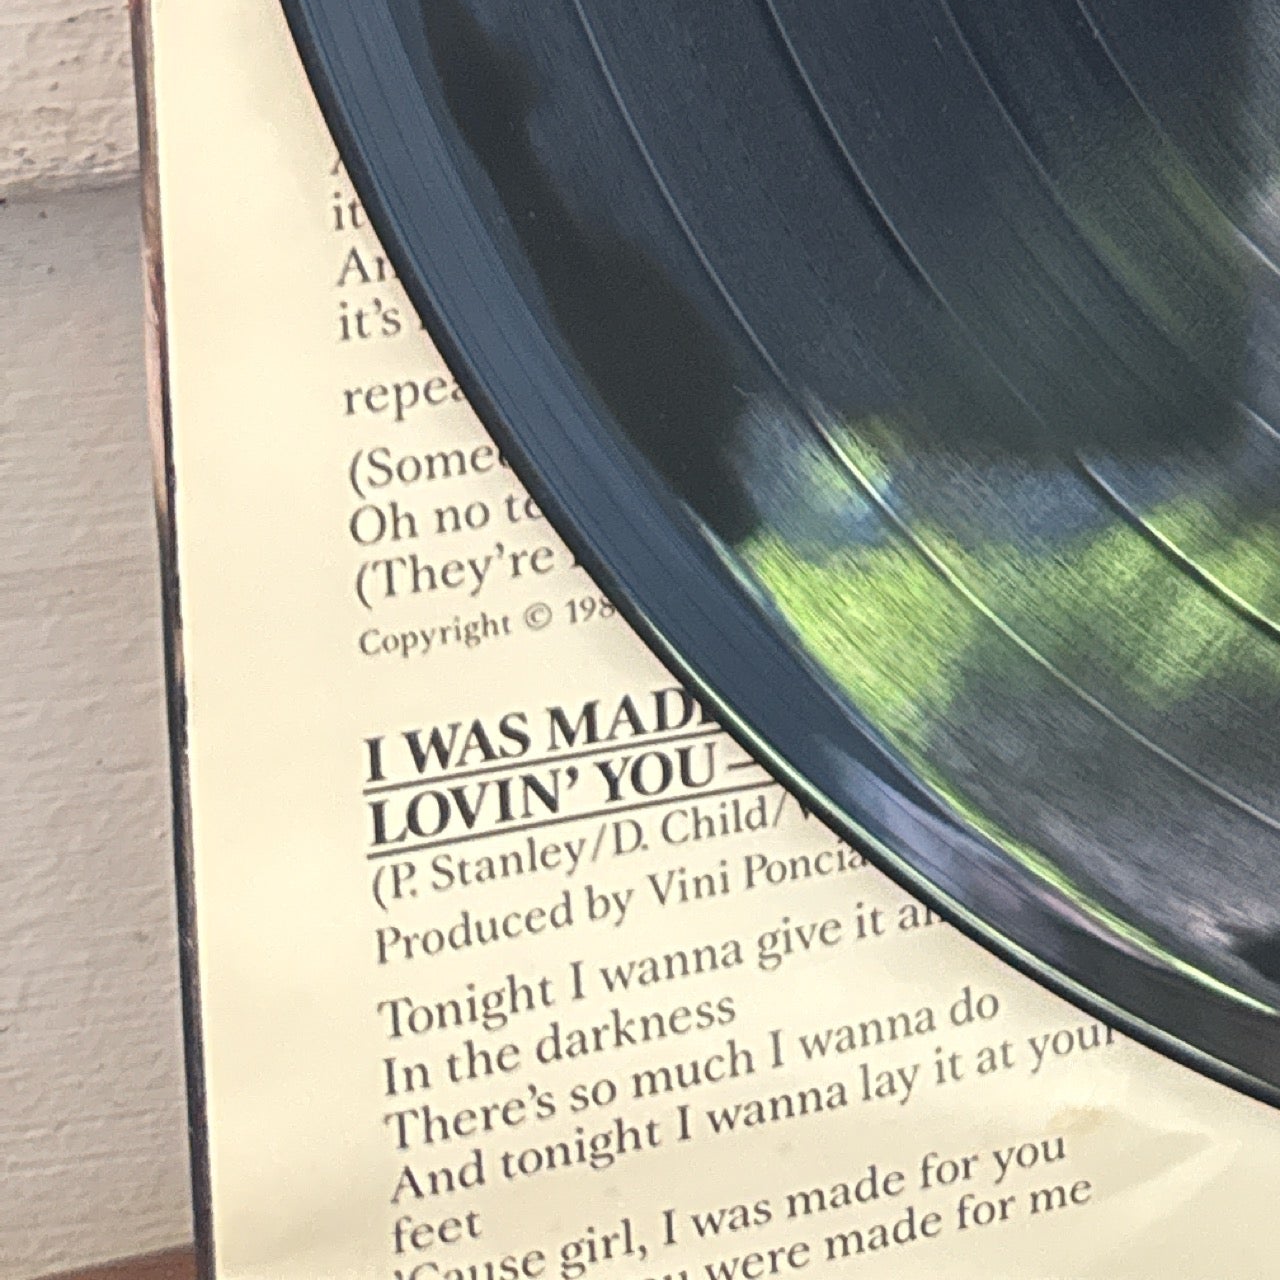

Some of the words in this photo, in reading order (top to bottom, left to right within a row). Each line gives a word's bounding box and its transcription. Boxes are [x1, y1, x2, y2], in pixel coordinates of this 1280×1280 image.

[355, 542, 554, 602] (They're
[359, 612, 511, 658] Copyright
[365, 736, 387, 782] I
[401, 712, 531, 774] WAS
[368, 767, 580, 845] LOVIN'
[594, 742, 717, 802] YOU
[376, 890, 573, 965] Produced
[584, 885, 634, 927] by
[647, 870, 730, 906] Vini
[383, 1057, 431, 1097] In
[446, 1040, 520, 1083] the
[536, 997, 735, 1065] darkness
[390, 1148, 485, 1204] And
[501, 1117, 661, 1180] tonight
[677, 1105, 691, 1141] I
[706, 1083, 848, 1134] wanna
[860, 1064, 920, 1106] lay
[935, 1053, 963, 1085] it
[977, 1041, 1014, 1075] at
[392, 1211, 481, 1255] feet
[704, 1243, 810, 1280] were
[824, 1206, 942, 1261] made
[957, 1194, 1016, 1230] for
[1030, 1181, 1091, 1215] me
